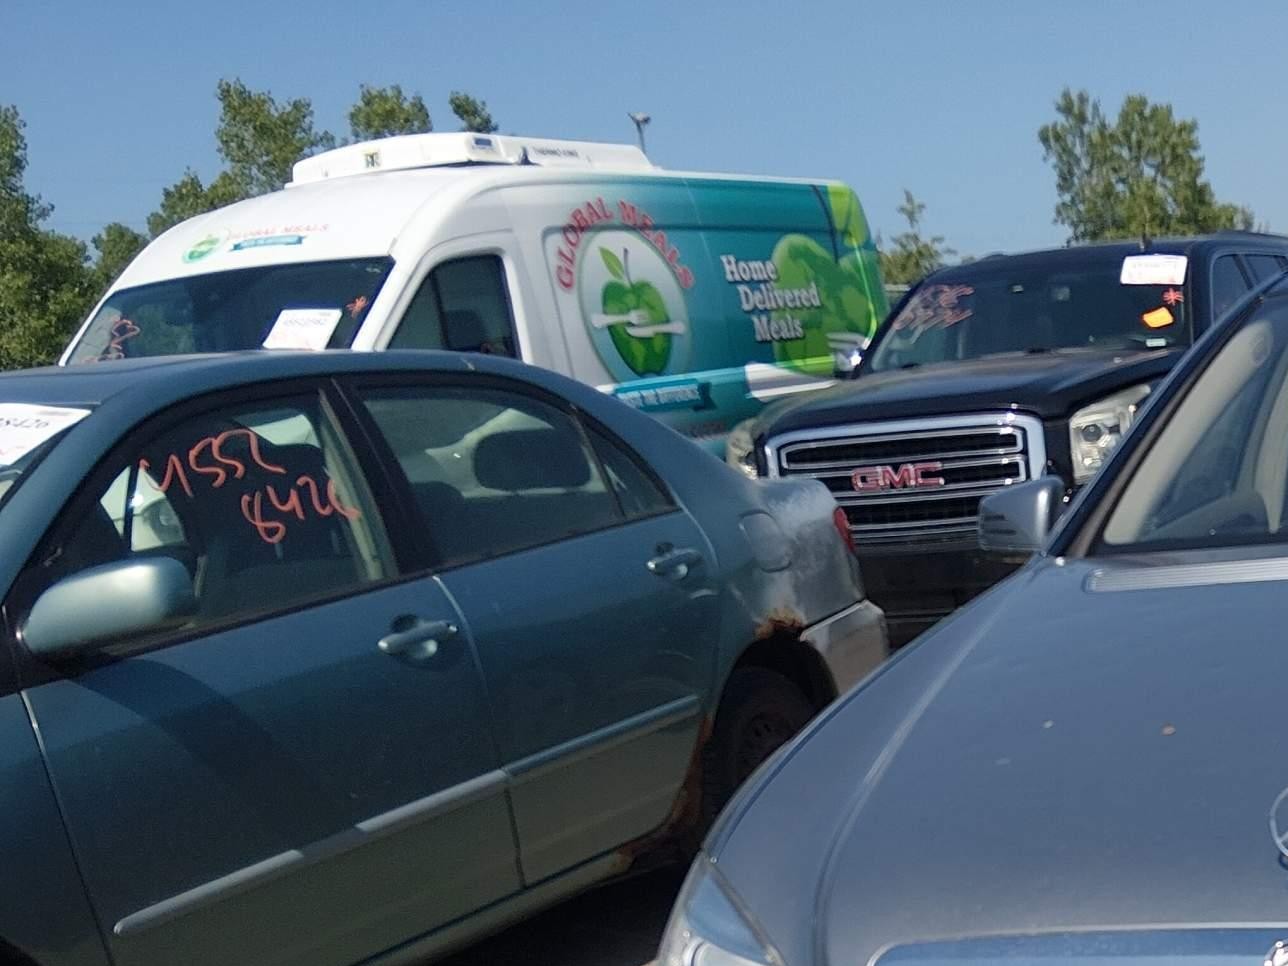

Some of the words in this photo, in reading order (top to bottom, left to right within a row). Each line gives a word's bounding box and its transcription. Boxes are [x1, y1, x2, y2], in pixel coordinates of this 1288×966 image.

[556, 197, 614, 293] GLOBAL
[720, 254, 778, 283] Home
[736, 281, 822, 312] Delivered
[751, 314, 805, 343] Meals
[850, 460, 945, 492] GMC
